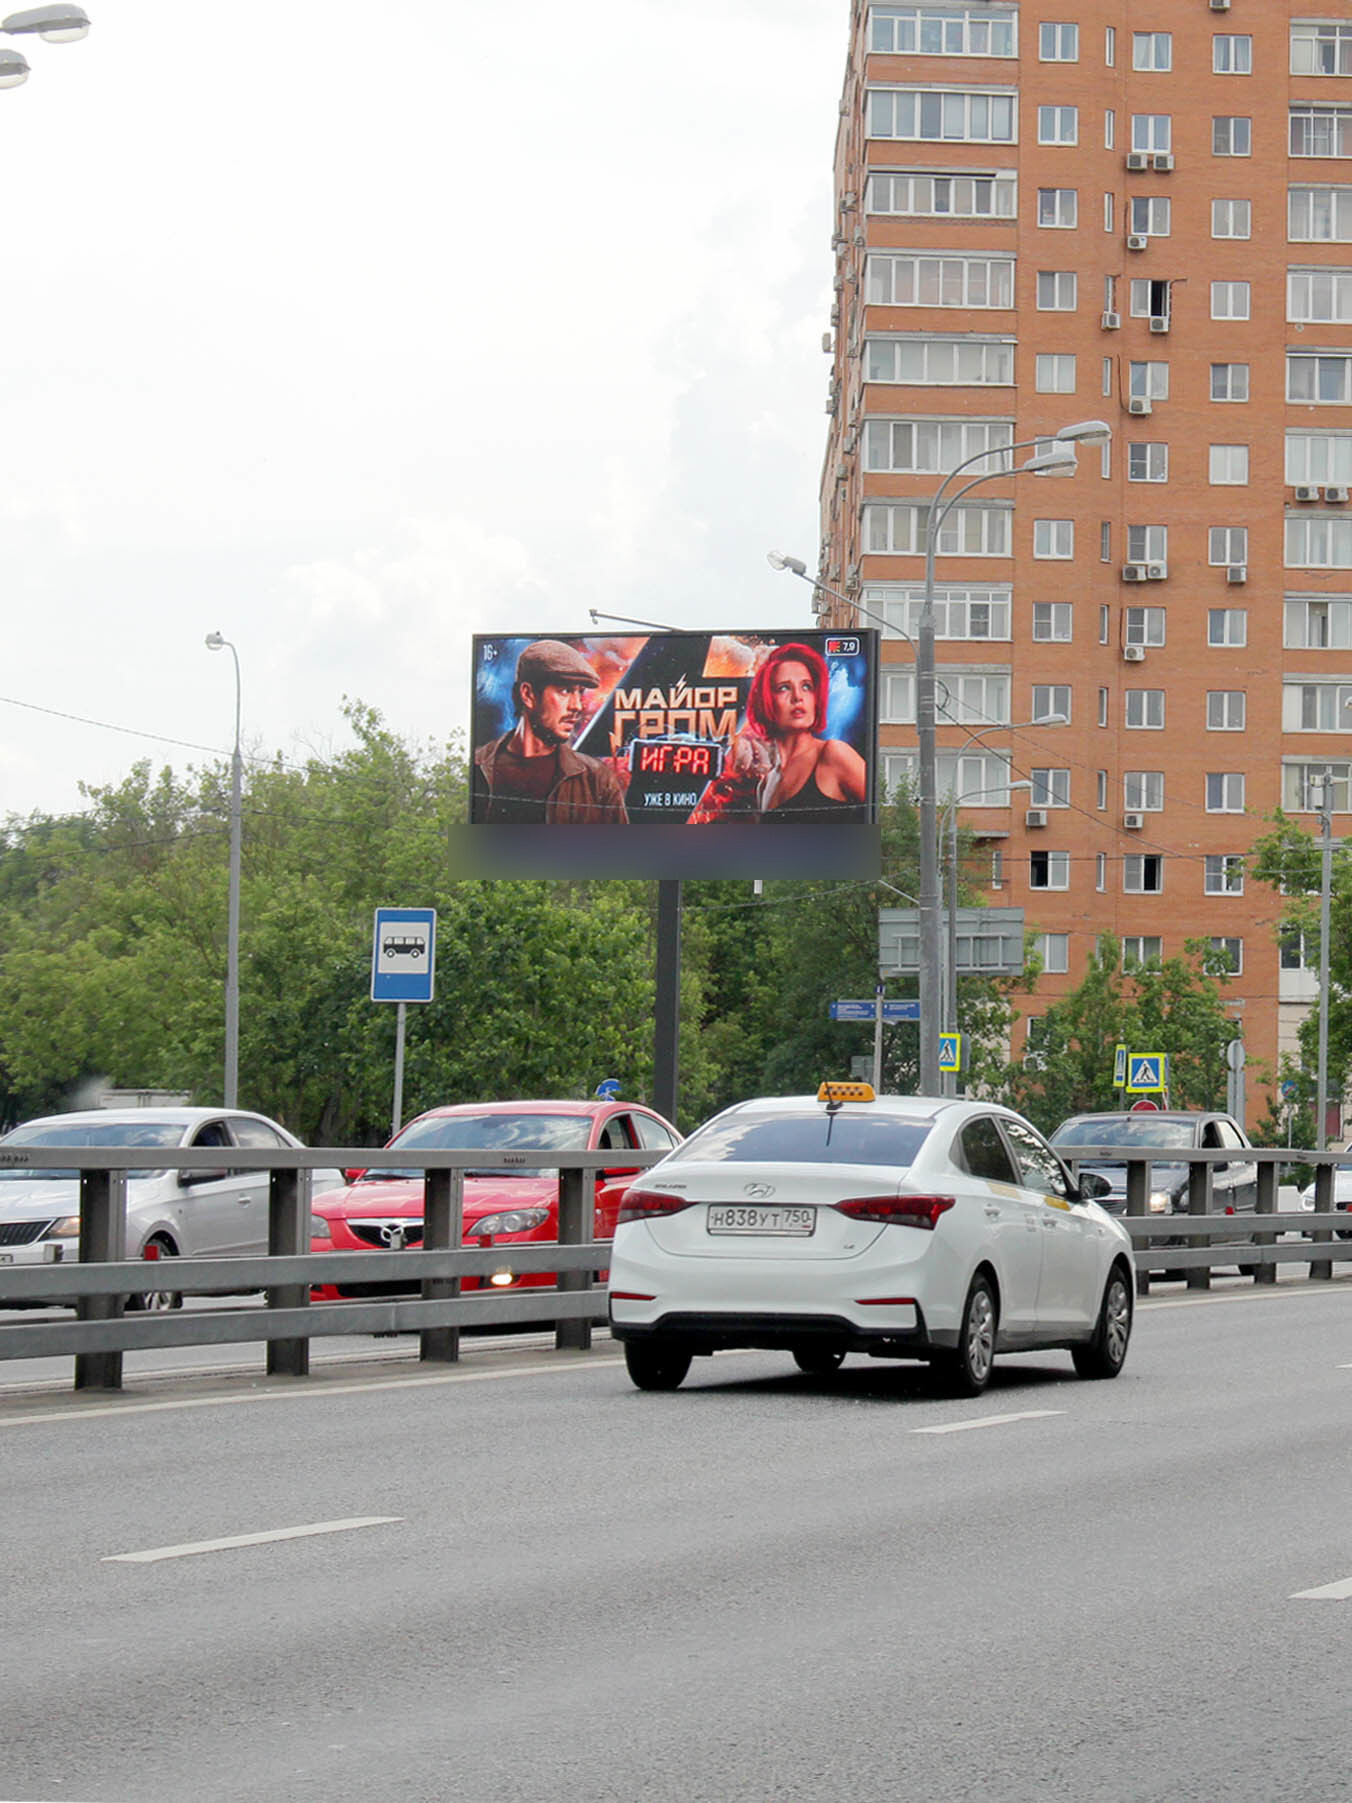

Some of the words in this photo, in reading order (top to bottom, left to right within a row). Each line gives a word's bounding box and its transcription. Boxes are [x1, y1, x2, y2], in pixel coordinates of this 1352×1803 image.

[615, 674, 738, 709] МАЙОР
[644, 793, 663, 806] УЖЕ
[664, 793, 671, 806] В
[673, 793, 697, 806] КИНО
[714, 1209, 779, 1226] Н838УТ
